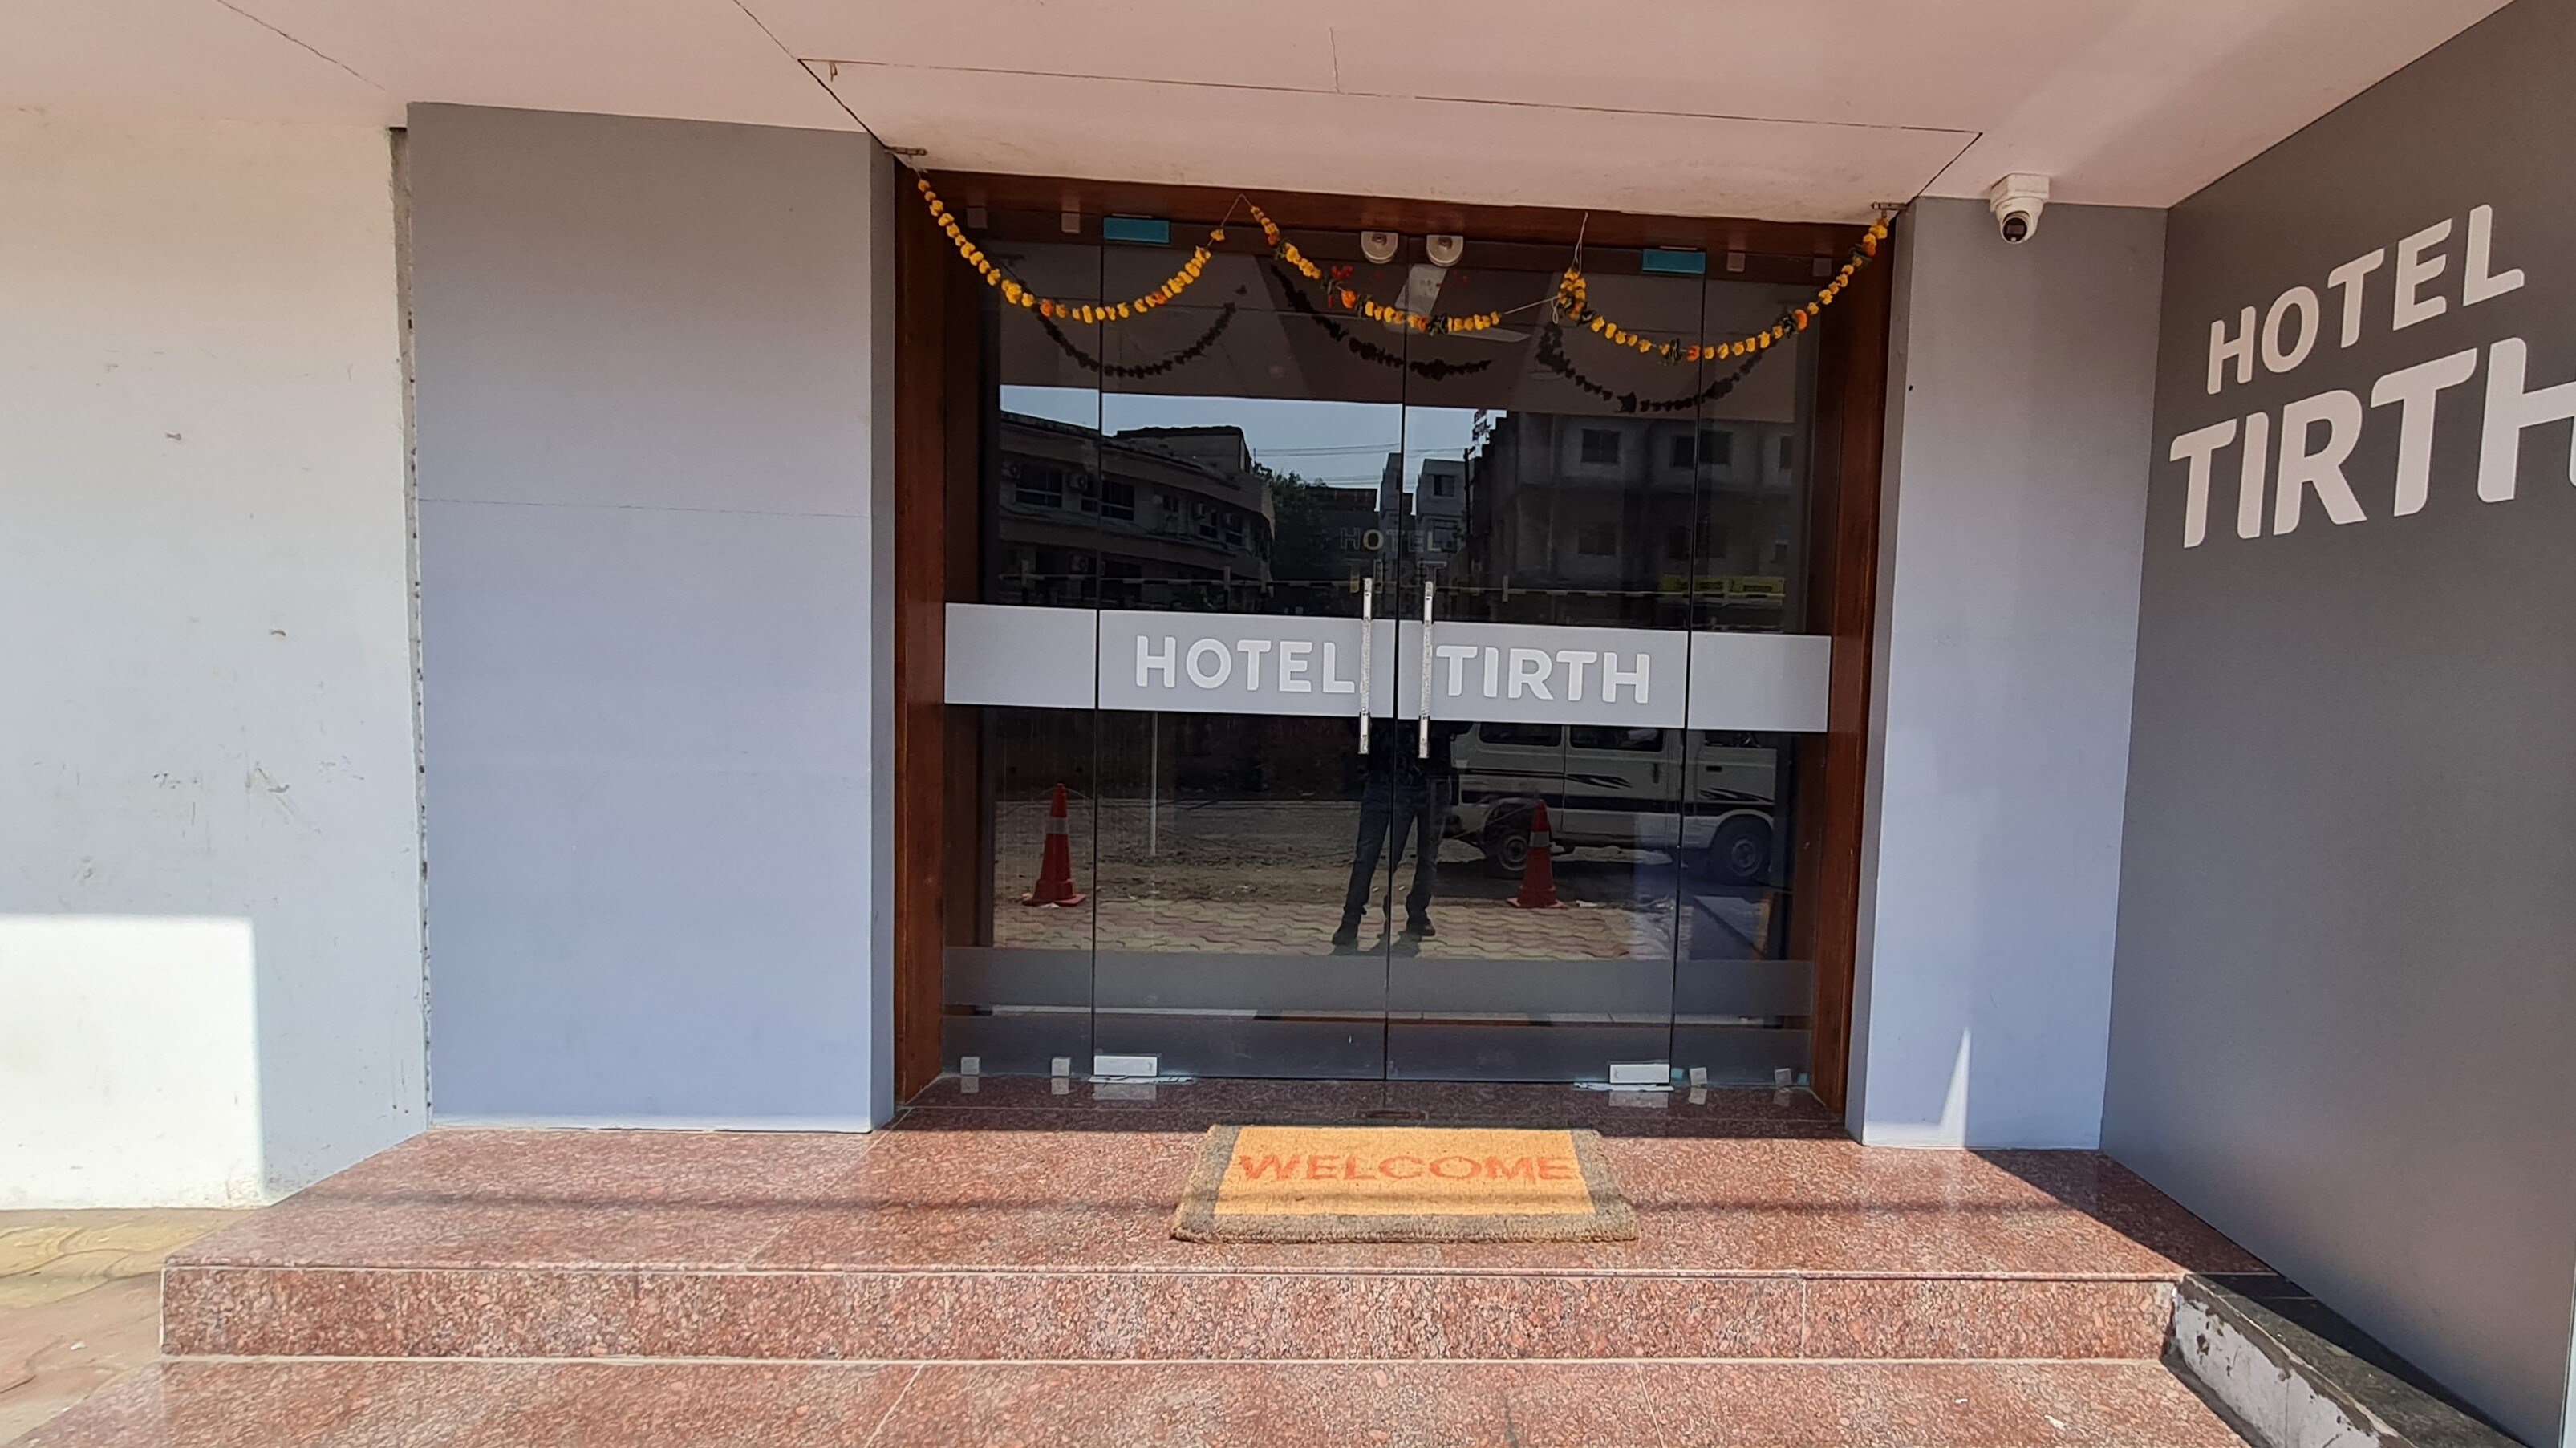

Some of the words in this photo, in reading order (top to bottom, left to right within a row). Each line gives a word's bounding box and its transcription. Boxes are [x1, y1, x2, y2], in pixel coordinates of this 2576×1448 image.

[2207, 205, 2525, 395] HOTEL
[1341, 527, 1442, 553] HOTEL
[1135, 635, 1356, 694] HOTEL
[1436, 645, 1651, 704] TIRTH
[1239, 1153, 1574, 1182] WELCOME
